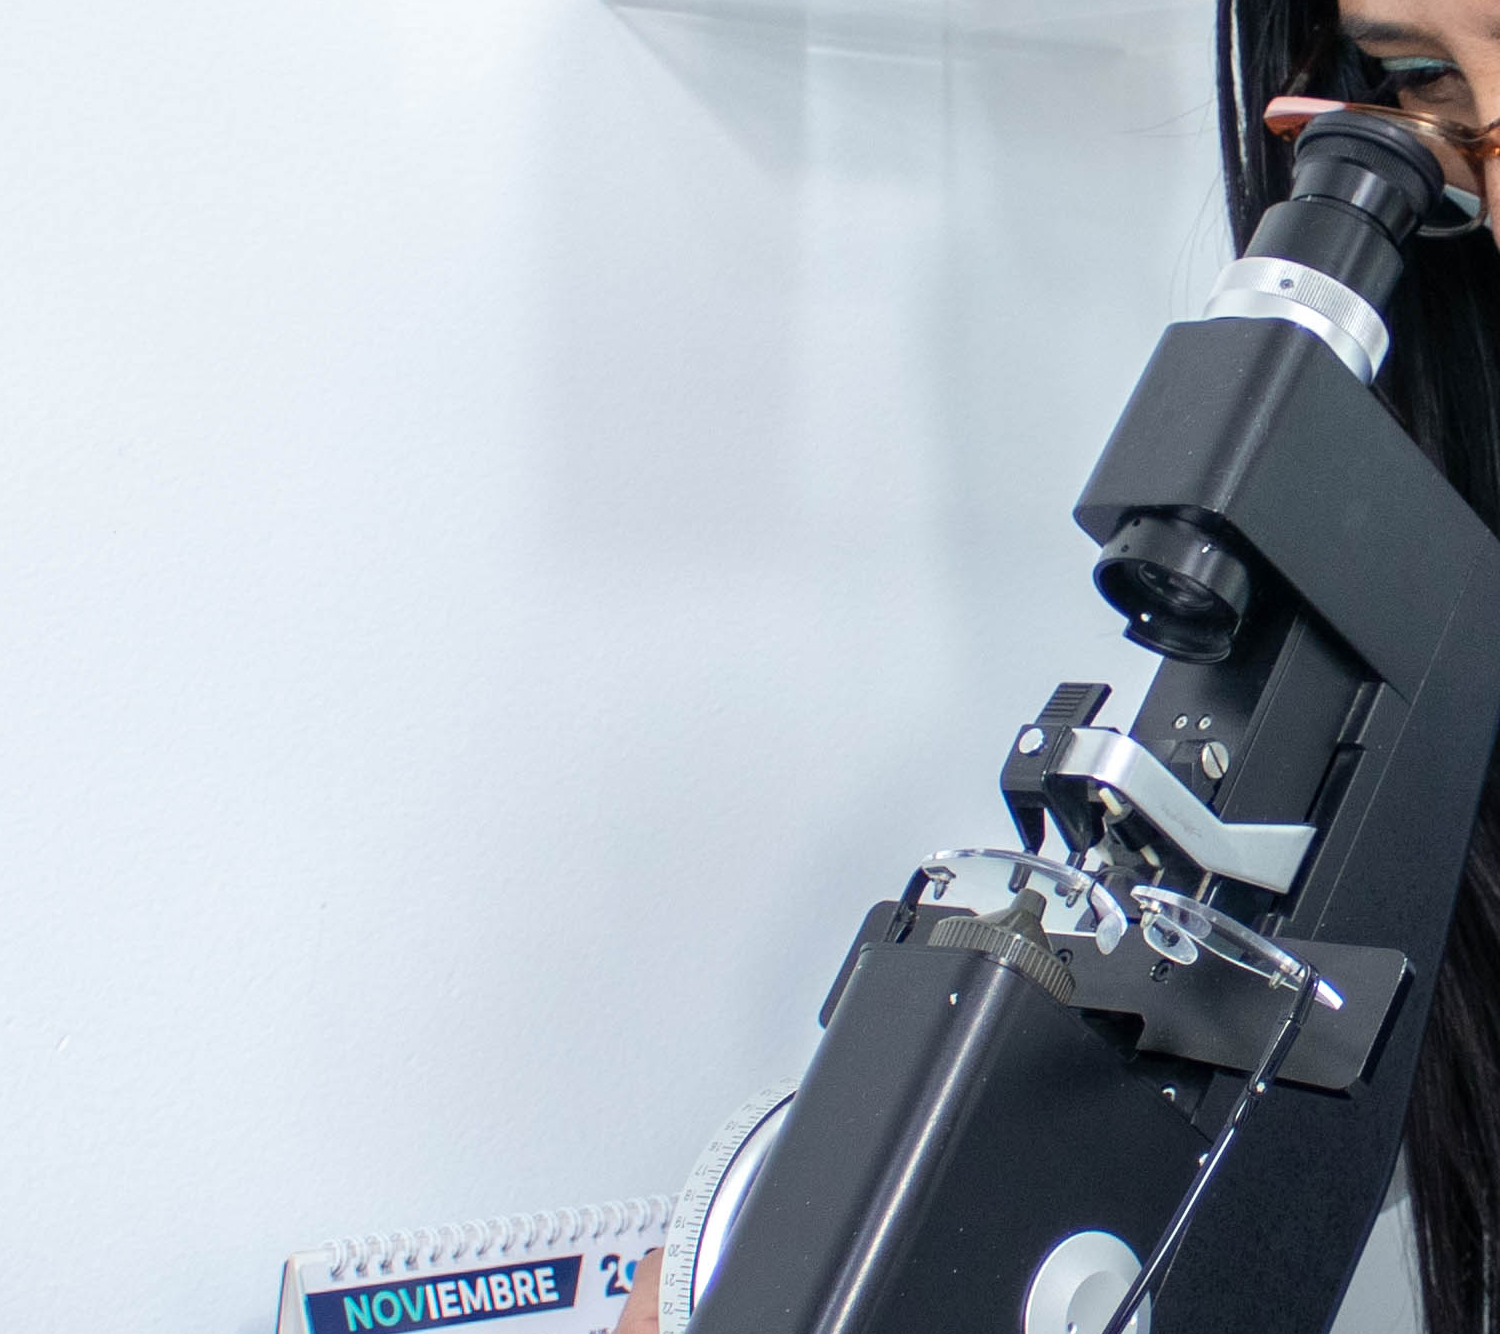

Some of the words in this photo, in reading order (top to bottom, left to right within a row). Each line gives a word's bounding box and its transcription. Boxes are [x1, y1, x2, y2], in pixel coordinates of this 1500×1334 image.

[668, 1244, 681, 1257] 20
[666, 1274, 675, 1286] 21
[343, 1267, 560, 1332] NOVIEMBRE
[663, 1302, 675, 1314] 22
